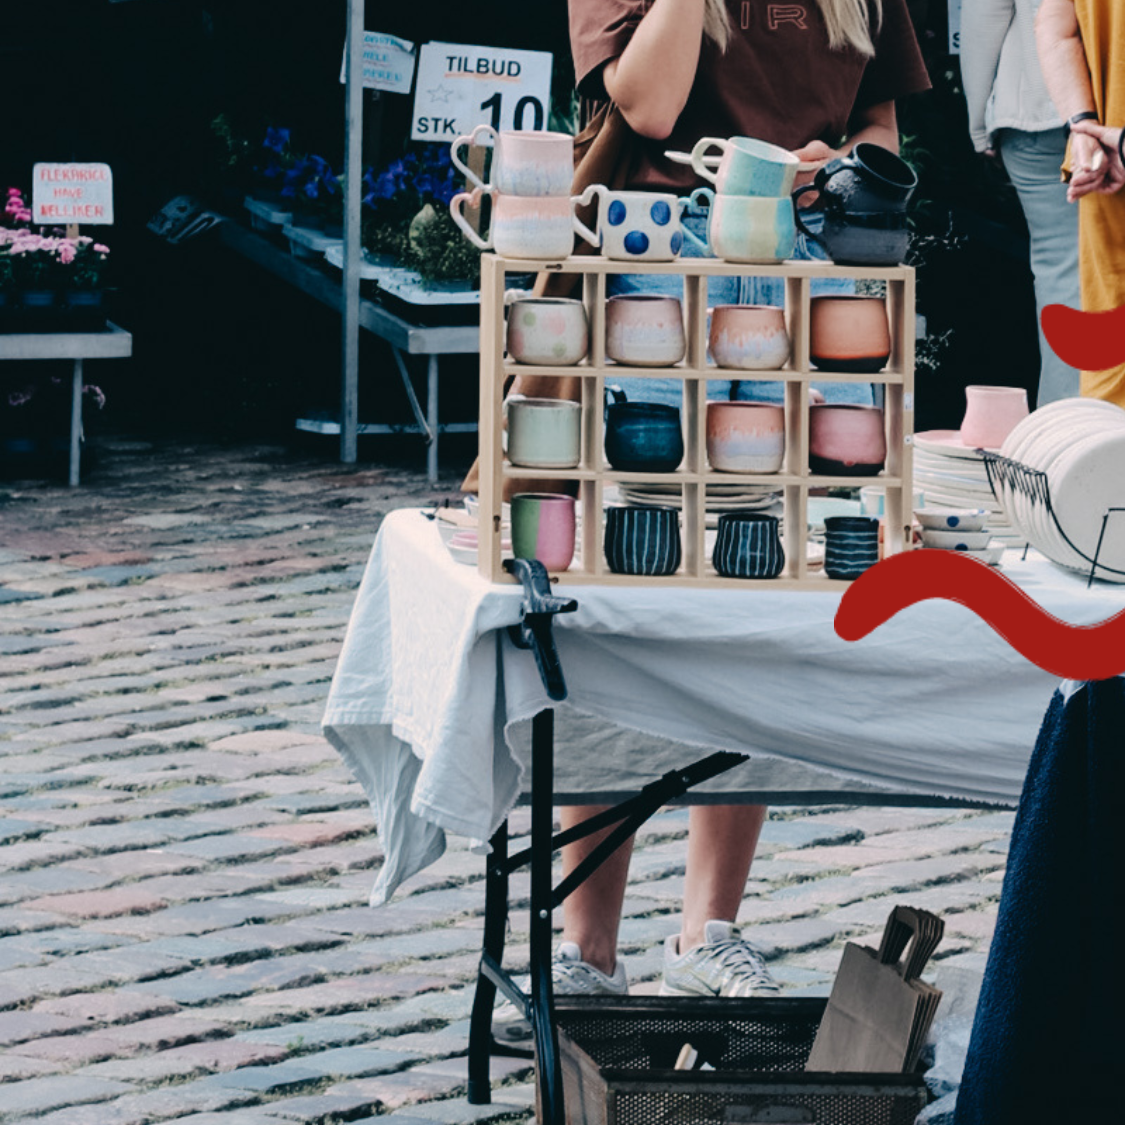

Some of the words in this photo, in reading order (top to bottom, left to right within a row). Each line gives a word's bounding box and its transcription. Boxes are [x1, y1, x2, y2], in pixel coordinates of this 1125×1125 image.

[446, 56, 521, 77] TILBUD
[480, 93, 544, 137] 10
[417, 117, 461, 135] STK.
